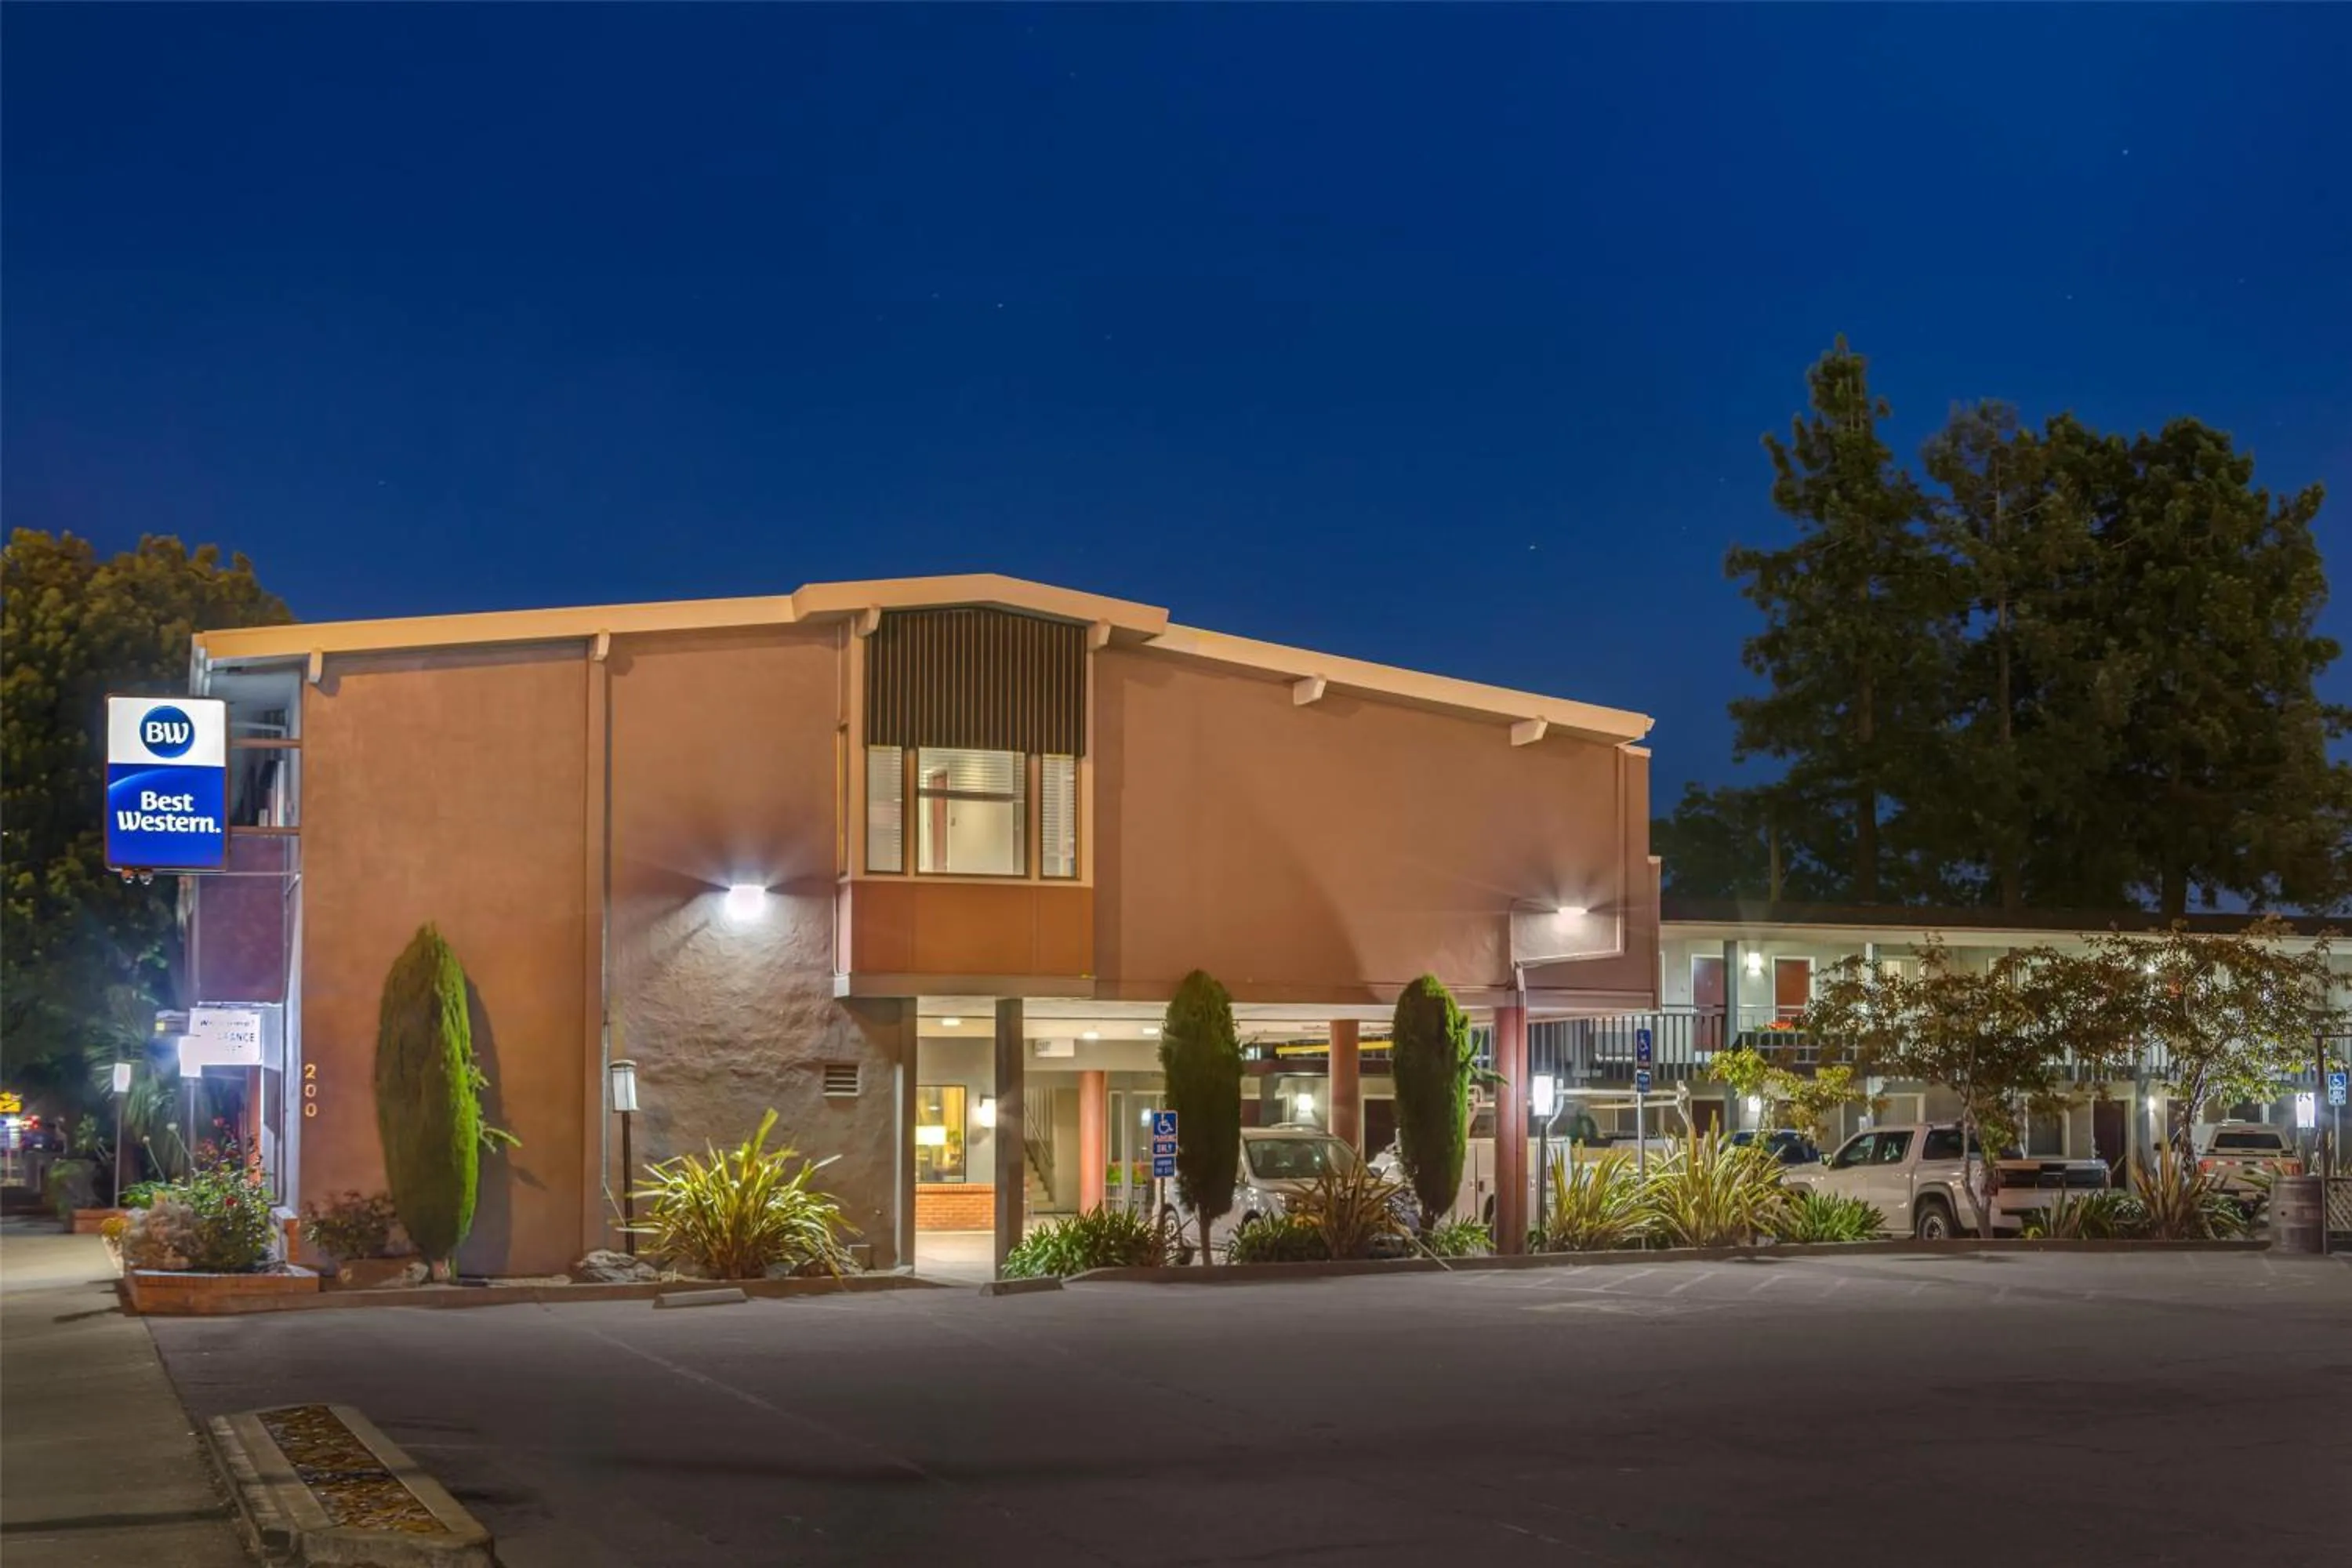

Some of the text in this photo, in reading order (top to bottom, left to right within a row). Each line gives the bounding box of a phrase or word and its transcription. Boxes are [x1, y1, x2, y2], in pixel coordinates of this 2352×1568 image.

[147, 721, 189, 744] BW
[140, 791, 194, 812] Best
[305, 1064, 318, 1117] 200
